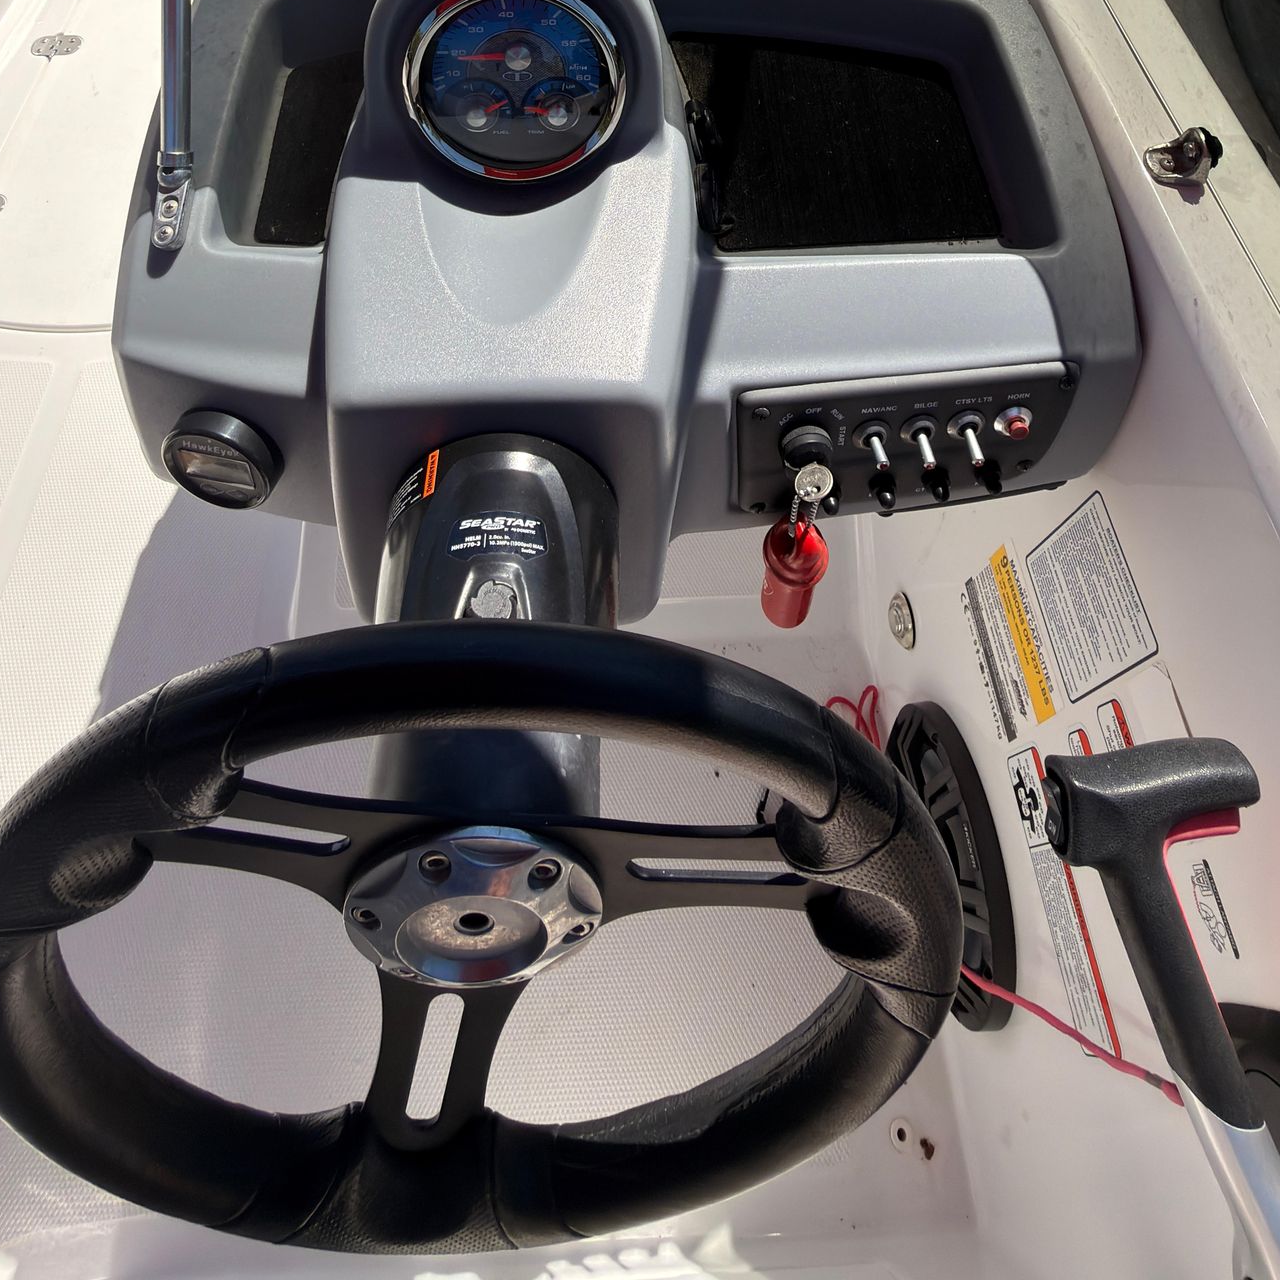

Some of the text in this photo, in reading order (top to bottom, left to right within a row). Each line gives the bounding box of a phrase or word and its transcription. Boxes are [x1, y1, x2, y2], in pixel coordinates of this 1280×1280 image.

[468, 26, 484, 34] 30
[1007, 392, 1031, 401] HORN
[914, 401, 939, 410] BILGE
[955, 398, 977, 406] CTSY
[805, 407, 823, 415] OFF
[779, 411, 794, 427] ACC
[838, 425, 847, 447] START
[999, 554, 1009, 569] 9
[1004, 567, 1026, 627] PERSONS
[1022, 626, 1032, 648] OR
[1028, 647, 1040, 677] 1237
[1038, 678, 1050, 706] LBS
[1009, 558, 1054, 695] MAXIMUM CAPACITIES
